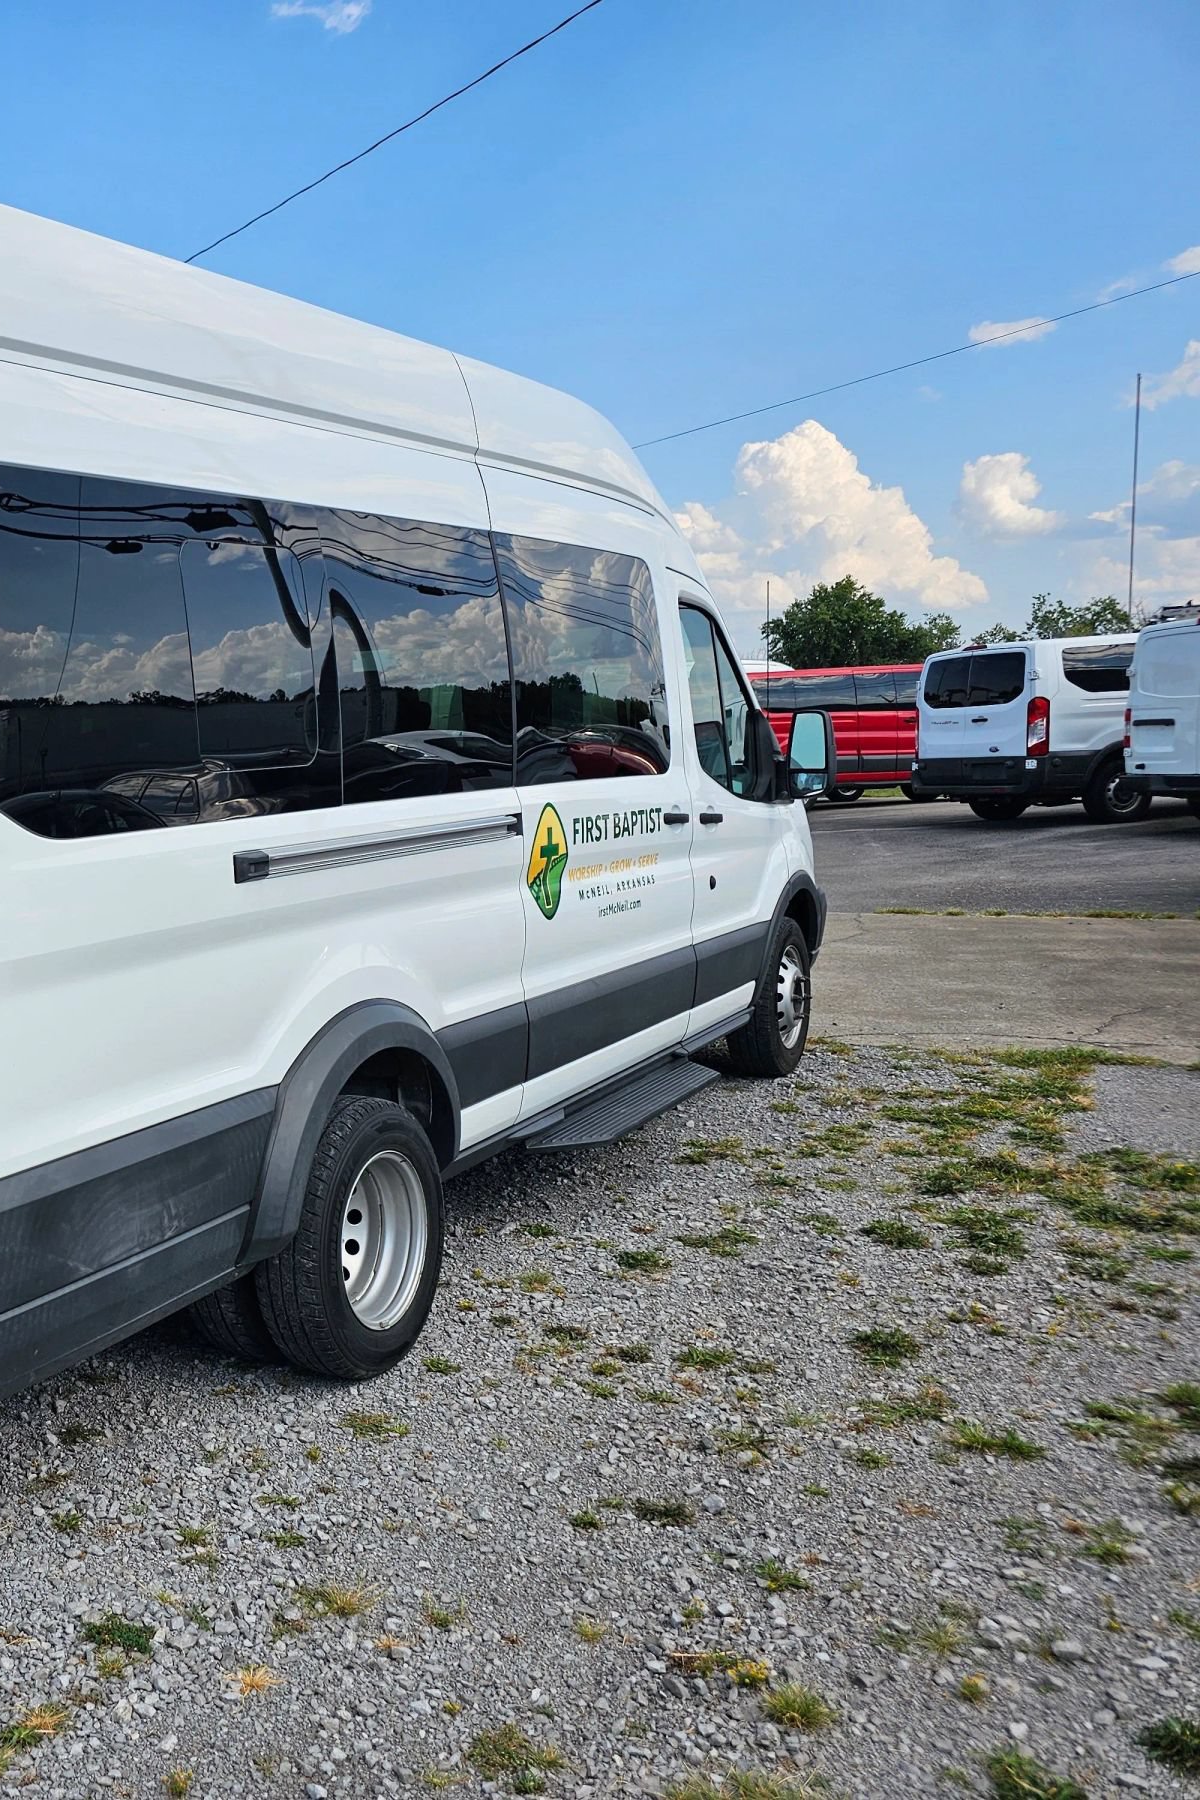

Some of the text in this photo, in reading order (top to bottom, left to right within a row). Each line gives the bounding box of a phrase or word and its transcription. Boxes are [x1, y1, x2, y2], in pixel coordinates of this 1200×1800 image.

[572, 807, 662, 845] FIRST BAPTIST
[568, 853, 659, 881] WORSHIP GROW SERVE
[616, 874, 656, 892] ARKANSAS
